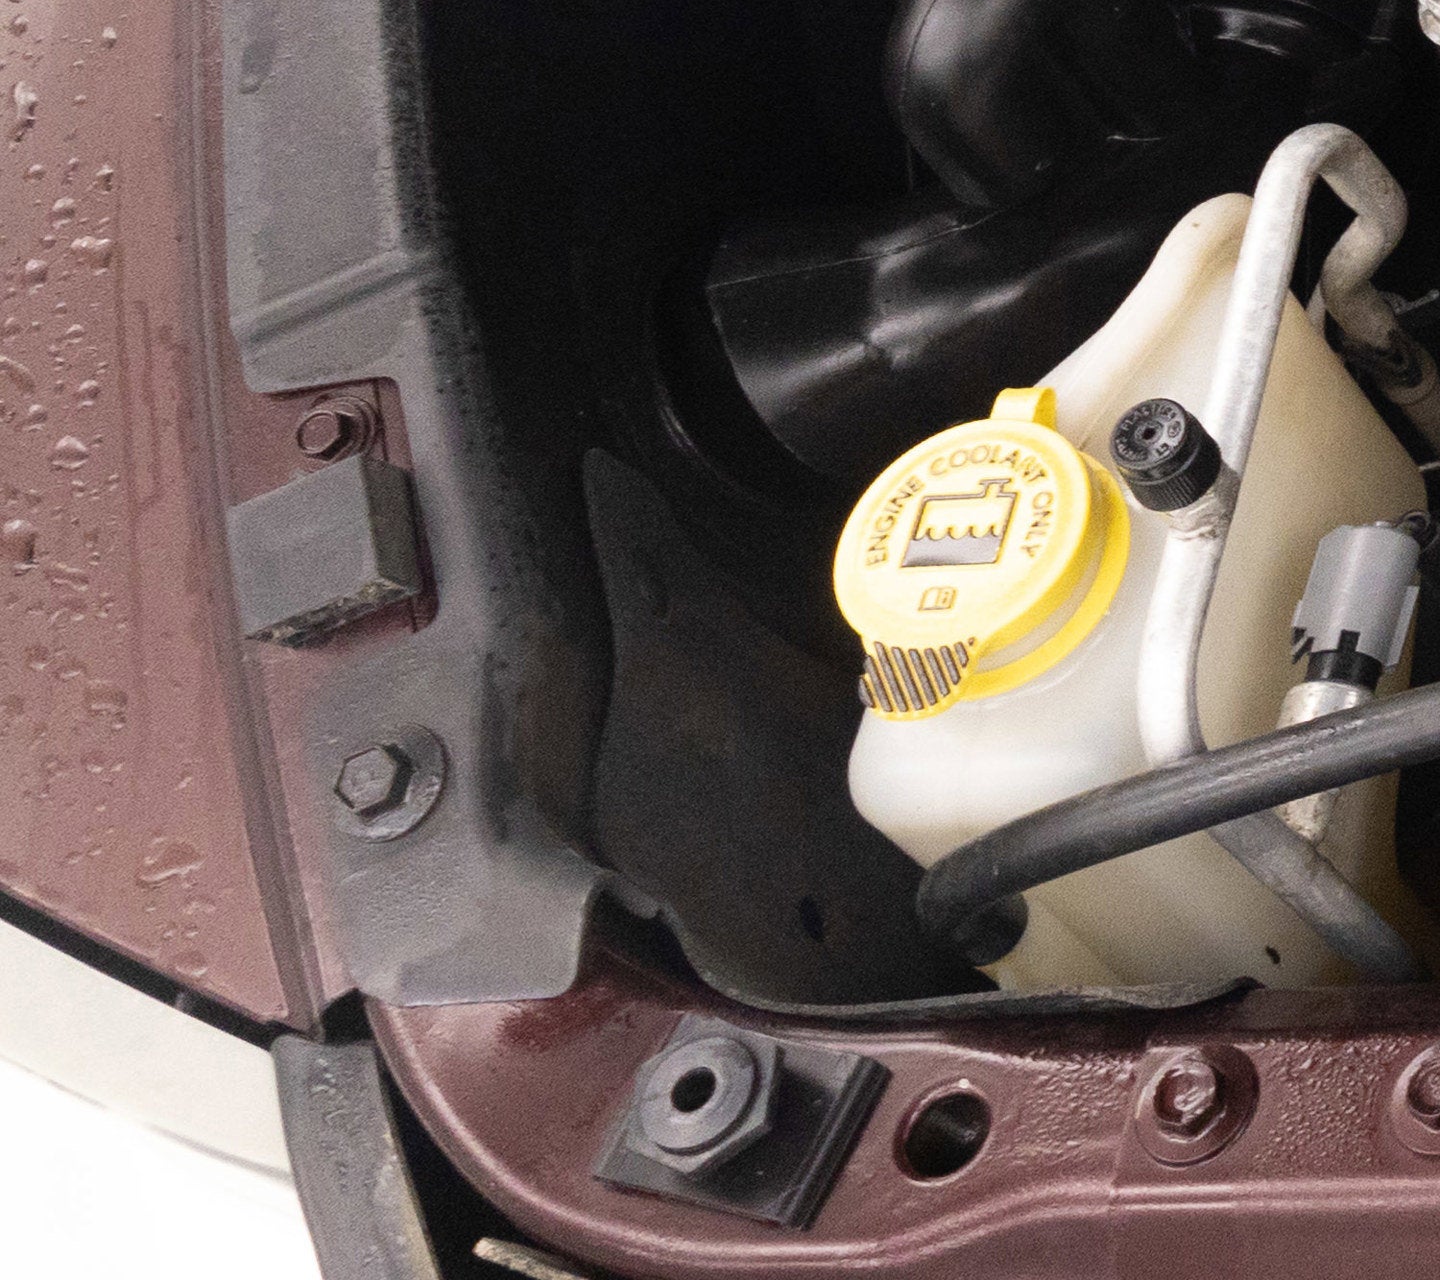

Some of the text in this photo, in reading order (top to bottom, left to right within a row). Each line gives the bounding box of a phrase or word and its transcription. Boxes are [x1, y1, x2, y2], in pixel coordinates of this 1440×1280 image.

[866, 445, 1055, 567] ENGINE COOLANT ONLY
